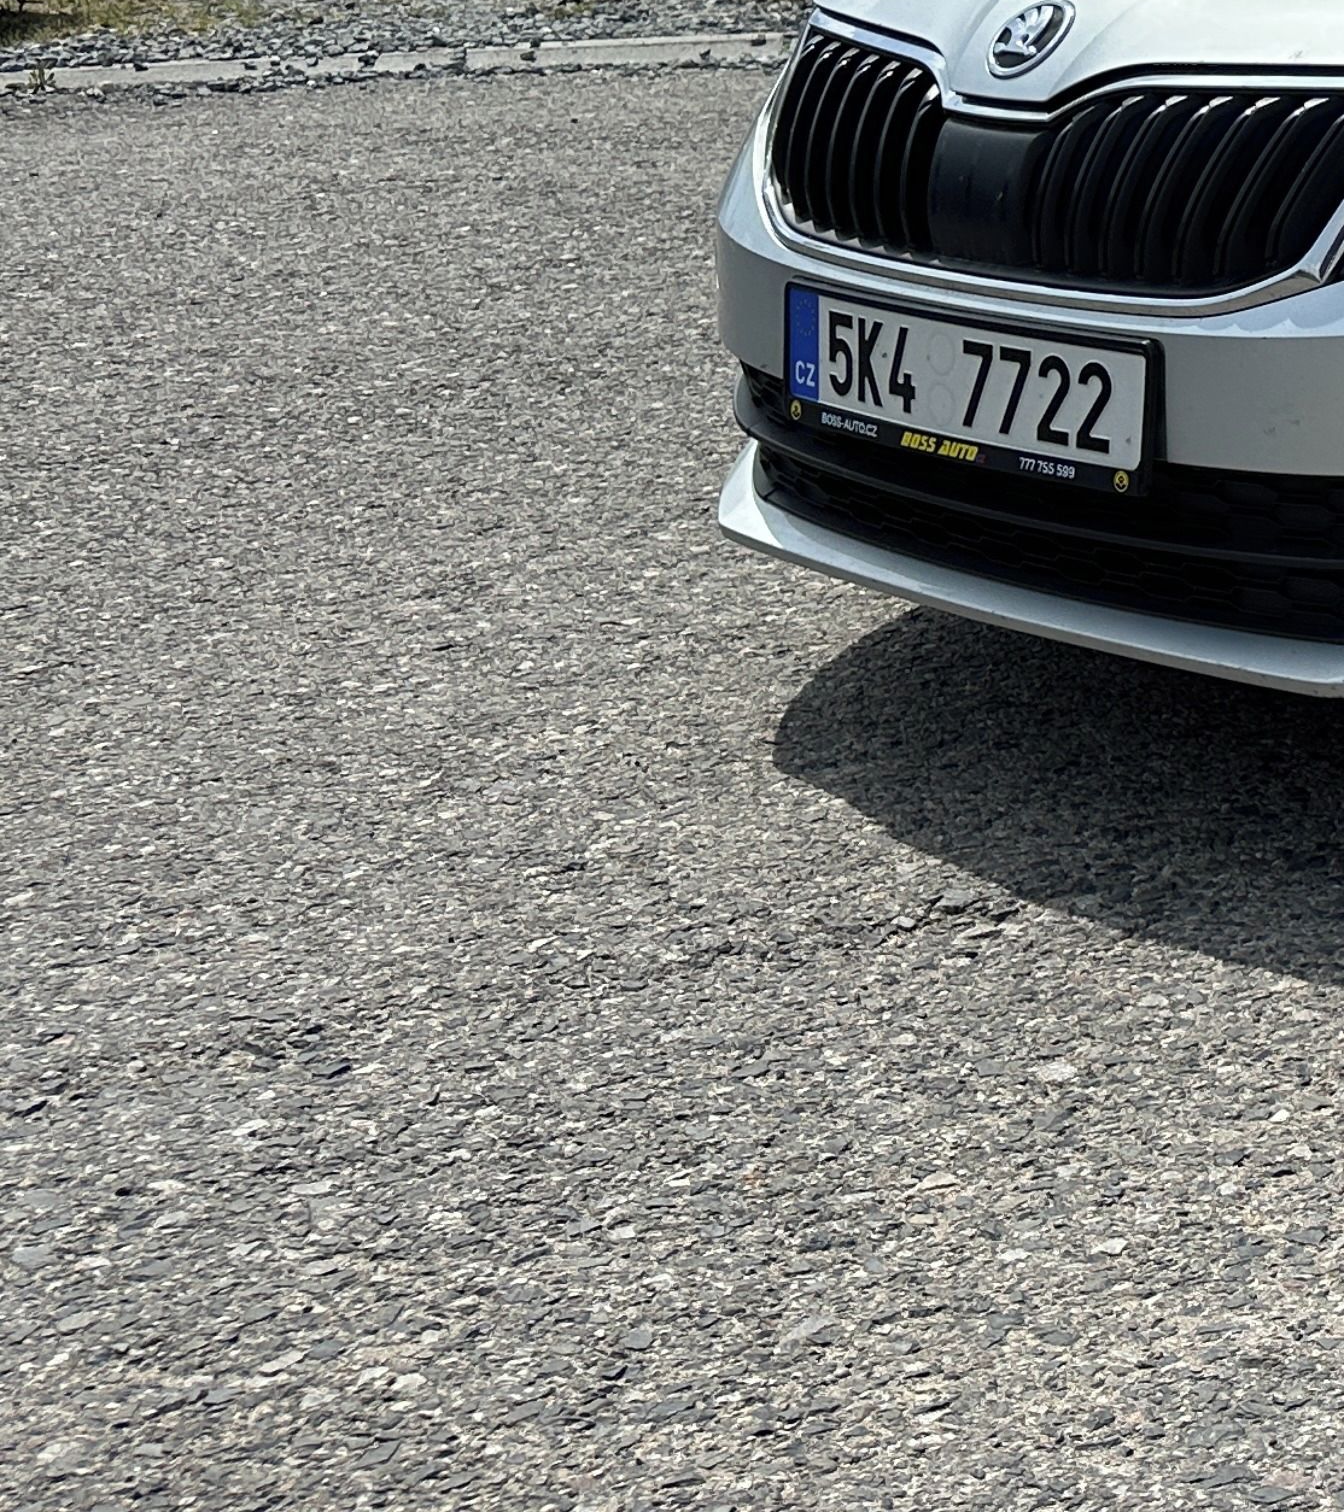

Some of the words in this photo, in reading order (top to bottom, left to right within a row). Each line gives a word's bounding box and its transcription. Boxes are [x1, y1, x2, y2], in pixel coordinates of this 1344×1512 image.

[795, 360, 815, 388] CZ
[828, 310, 916, 414] 5K4
[962, 339, 1112, 455] 7722
[901, 431, 936, 454] BOSS
[938, 440, 978, 461] AUTO
[1019, 456, 1035, 472] 777
[1036, 459, 1055, 476] 755
[1056, 464, 1076, 479] 599
